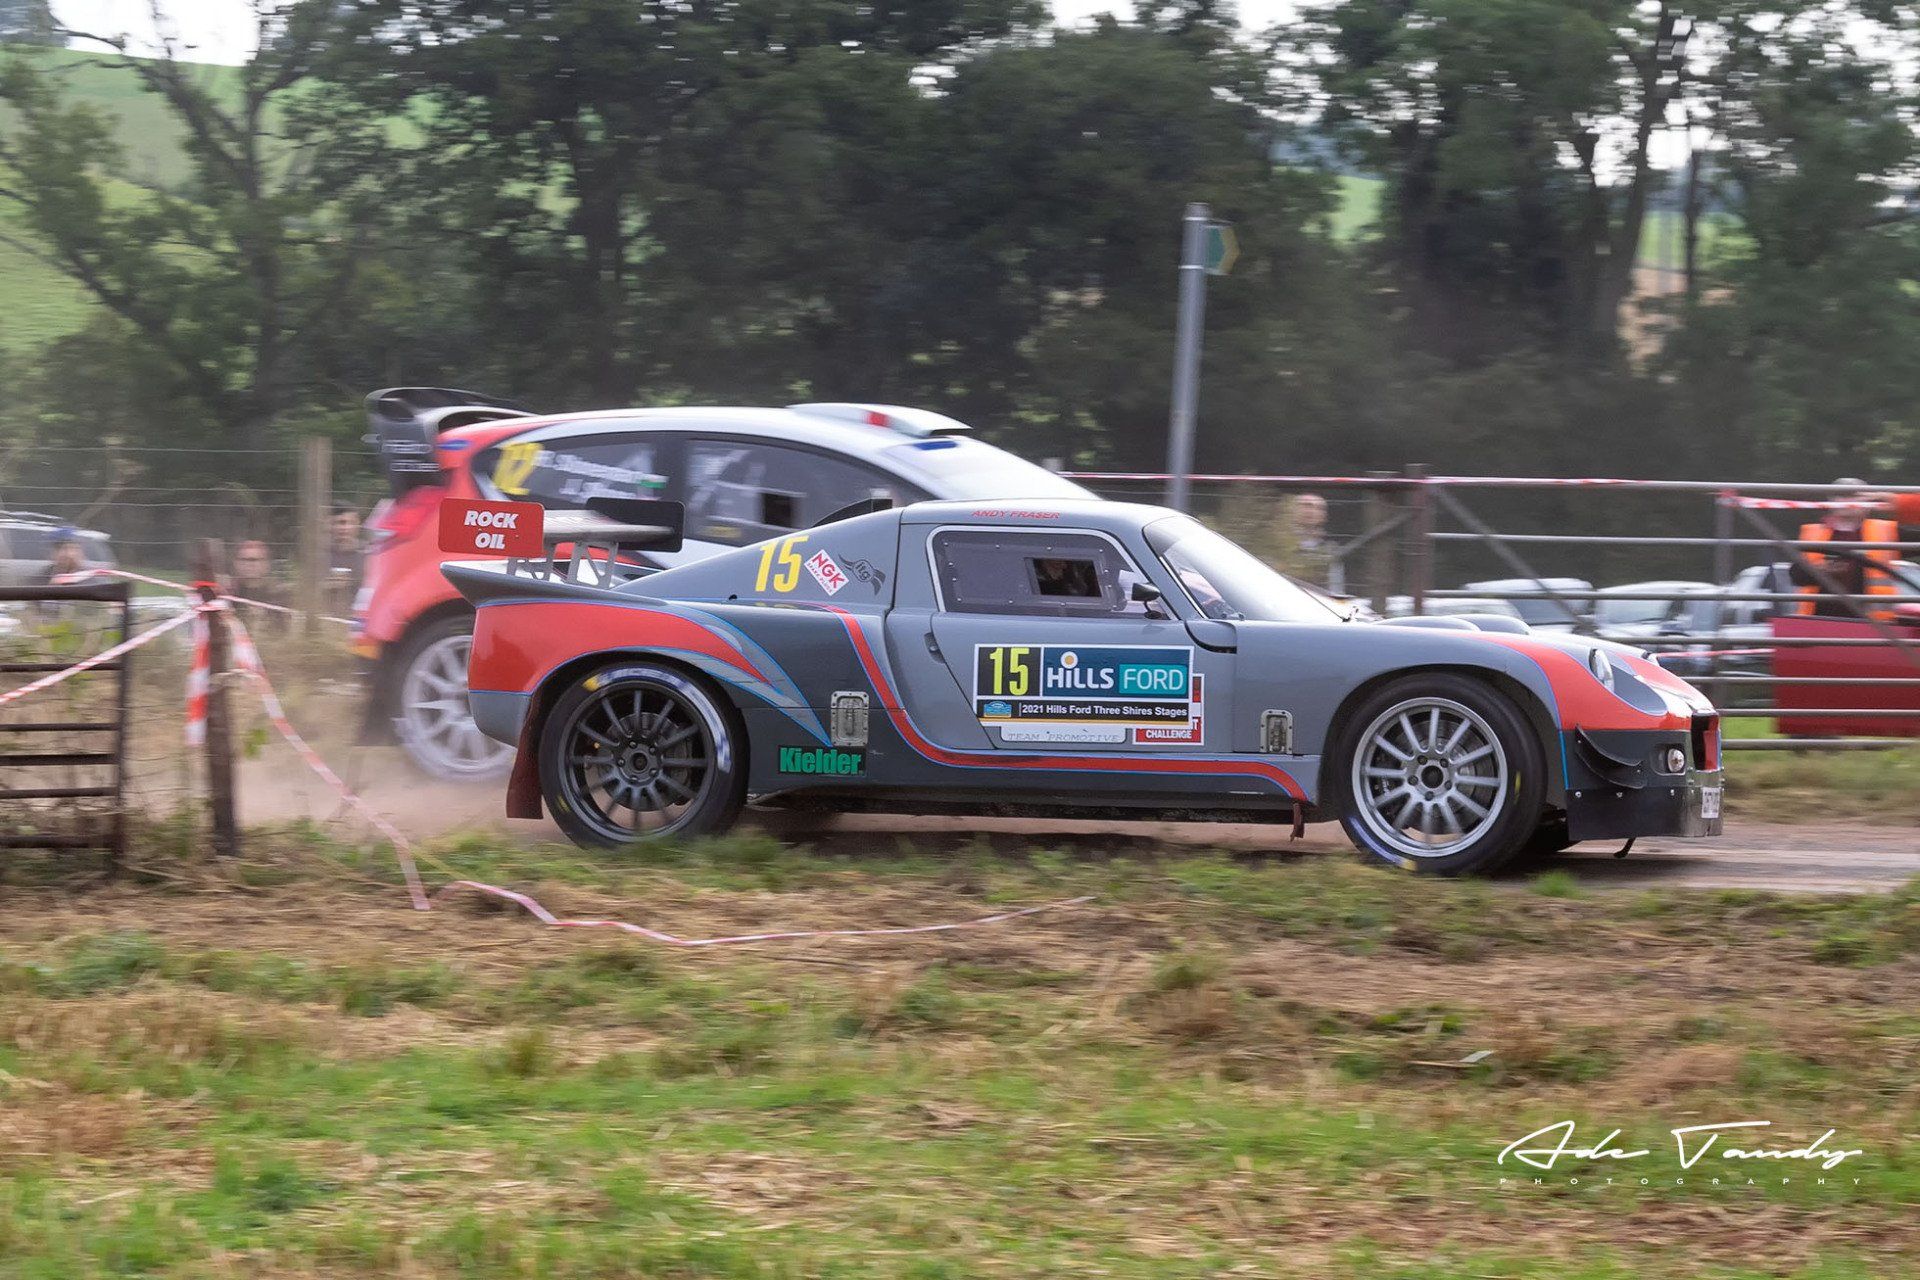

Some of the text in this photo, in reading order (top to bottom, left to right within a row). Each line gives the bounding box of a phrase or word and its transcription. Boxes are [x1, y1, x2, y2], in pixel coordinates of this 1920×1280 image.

[491, 442, 545, 495] 12
[464, 510, 519, 529] ROCK
[971, 509, 1060, 519] ANDY FRASER
[475, 532, 506, 549] OIL
[754, 535, 810, 592] 15
[812, 553, 845, 589] NGK
[989, 647, 1030, 696] 15
[1123, 668, 1184, 690] FORD
[1022, 704, 1044, 714] 2021
[1046, 704, 1067, 715] Hills
[1069, 705, 1091, 715] Ford
[1093, 705, 1121, 716] Three
[1122, 706, 1153, 716] Shires
[1154, 706, 1188, 718] Stages
[1008, 733, 1119, 742] TEAM PROMOTIVE
[1145, 729, 1192, 739] CHALLENGE
